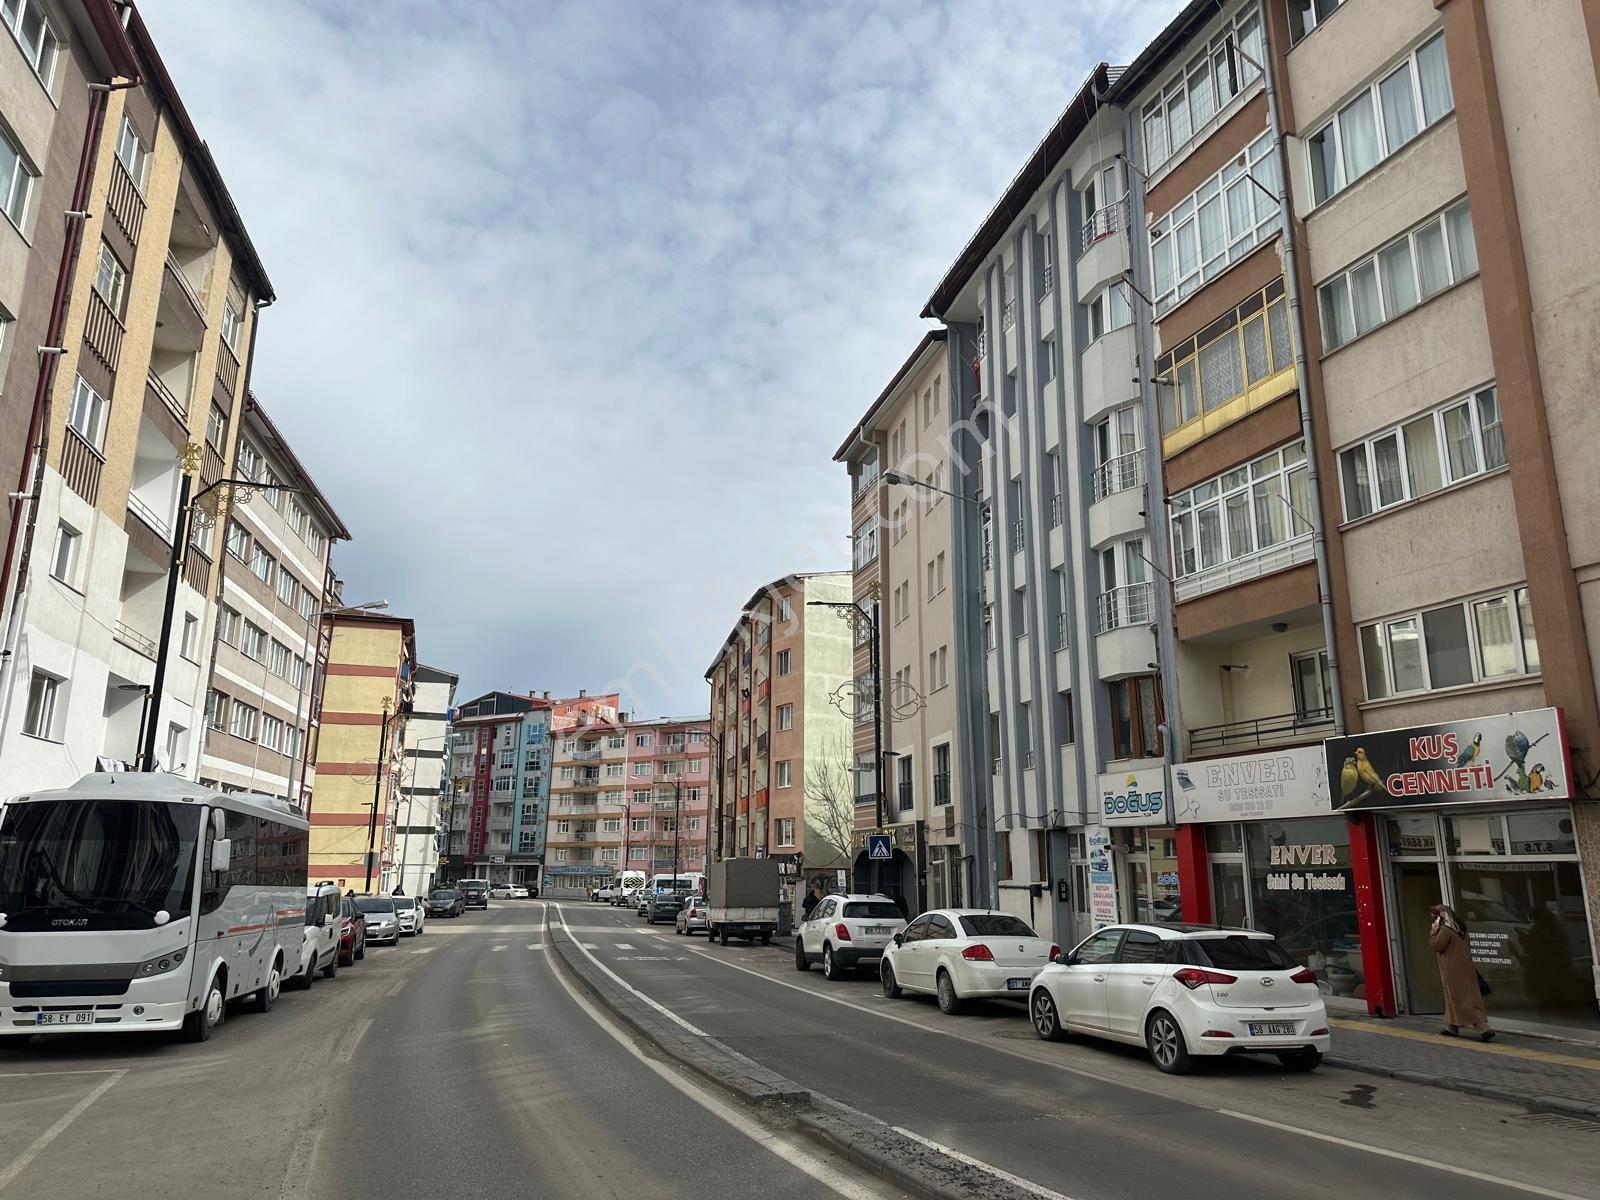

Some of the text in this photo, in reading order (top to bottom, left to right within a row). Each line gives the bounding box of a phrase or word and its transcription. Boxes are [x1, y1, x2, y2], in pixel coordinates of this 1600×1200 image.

[1409, 733, 1459, 764] KUŞ
[1206, 756, 1296, 788] ENVER
[1386, 760, 1495, 798] CENNETİ
[1104, 790, 1163, 815] DOĞUŞ
[1217, 789, 1231, 801] SU
[1270, 844, 1337, 865] ENVER
[1291, 873, 1304, 890] Su
[51, 918, 88, 926] OTOKAR
[43, 1013, 91, 1023] 58 EY 091
[1254, 1025, 1263, 1034] 58
